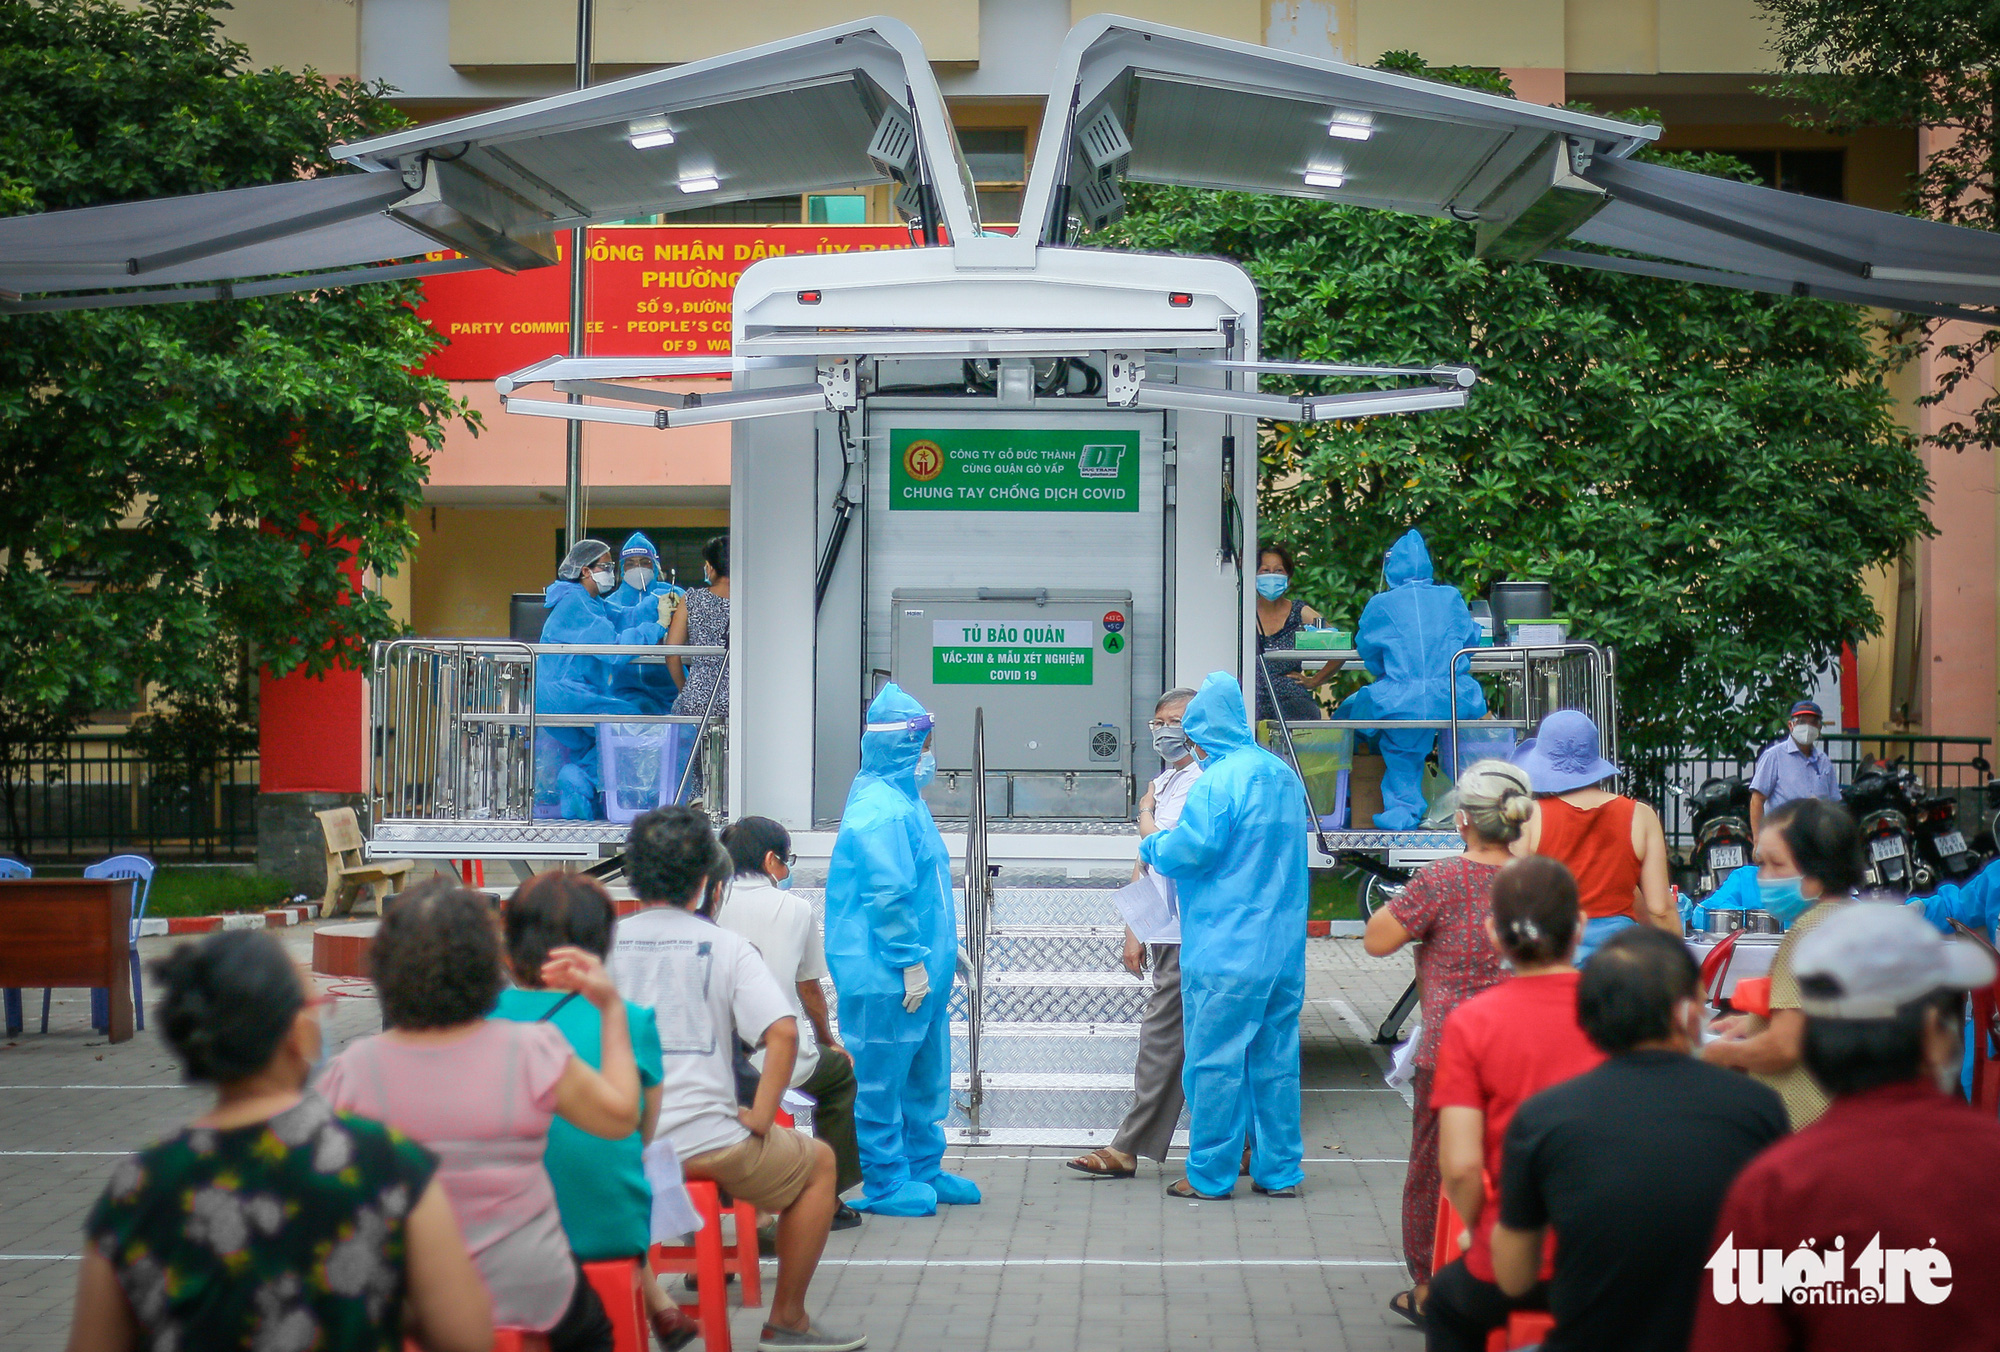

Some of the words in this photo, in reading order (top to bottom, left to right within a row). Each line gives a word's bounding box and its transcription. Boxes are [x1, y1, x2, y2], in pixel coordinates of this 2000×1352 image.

[585, 236, 644, 262] ỒNG
[654, 239, 724, 261] NHÂN
[734, 239, 786, 261] DÂN
[636, 296, 661, 314] SỐ
[450, 321, 504, 335] PARTY
[662, 339, 684, 352] OF
[686, 339, 698, 352] 9
[949, 448, 980, 460] CÔNG
[982, 450, 996, 460] TY
[998, 447, 1014, 460] GỖ
[1016, 448, 1038, 460] ĐỨC
[1040, 448, 1076, 460] THÀNH
[961, 462, 992, 474] CÙNG
[994, 462, 1023, 475] QUẬN
[1026, 462, 1041, 474] GÒ
[1044, 461, 1065, 474] VẤP
[902, 486, 953, 499] CHUNG
[957, 487, 985, 499] TAY
[989, 483, 1040, 500] CHỐNG
[1044, 487, 1078, 501] DỊCH
[1082, 488, 1126, 500] COVID
[962, 623, 982, 643] TỦ
[987, 623, 1018, 643] BẢO
[1023, 624, 1065, 645] QUẢN
[1108, 637, 1119, 649] A
[986, 654, 995, 664] &
[997, 649, 1021, 664] MẪU
[1023, 651, 1042, 664] XÉT
[1044, 651, 1085, 667] NGHIỆM
[989, 670, 1021, 681] COVID
[1024, 670, 1037, 681] 19
